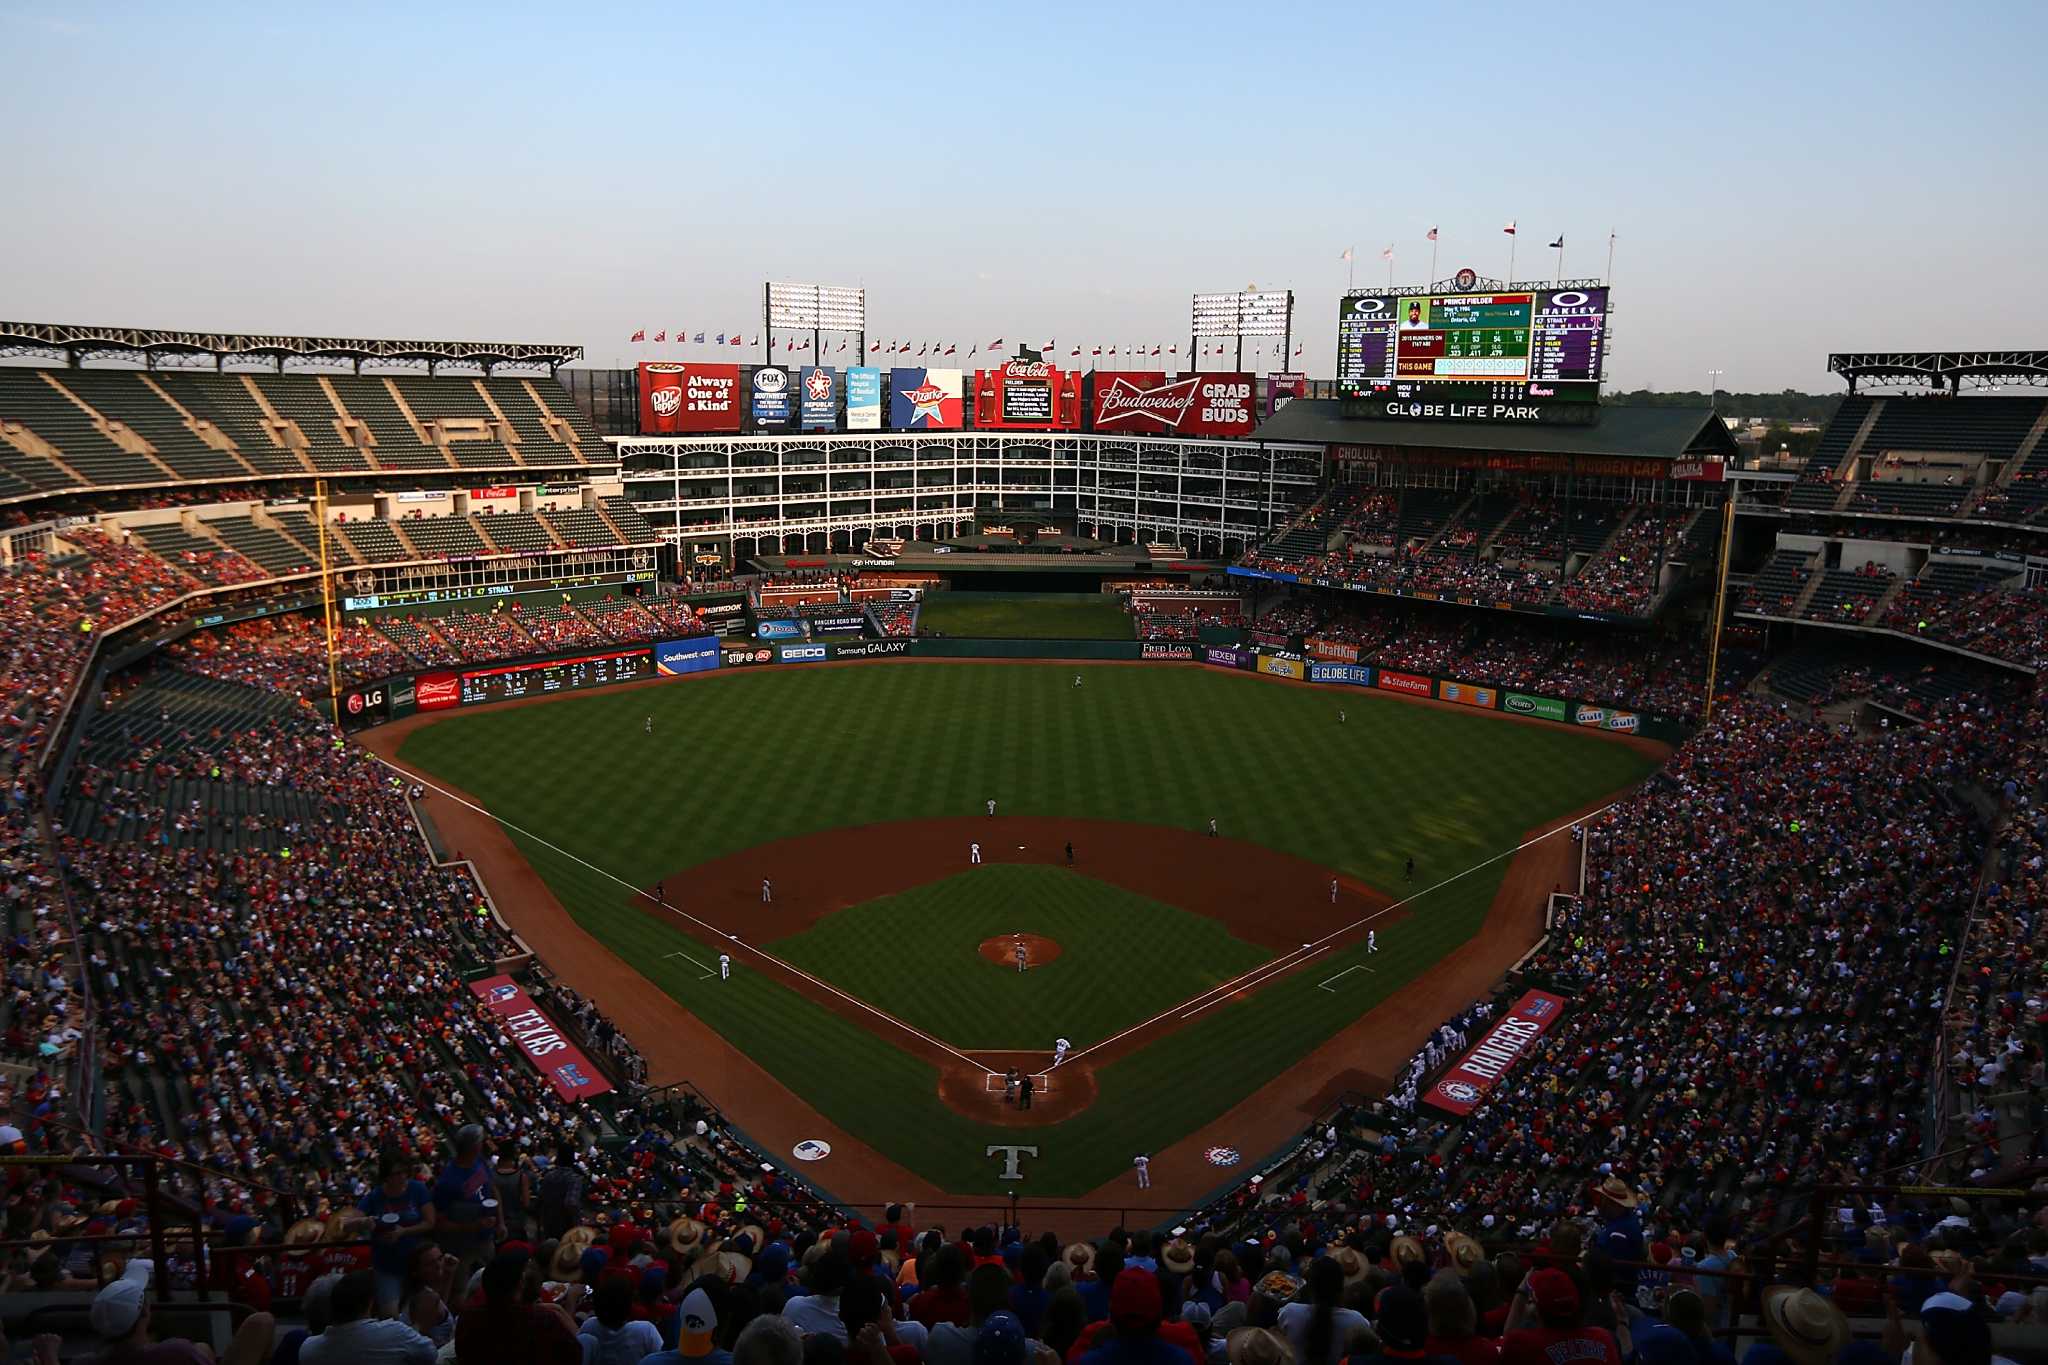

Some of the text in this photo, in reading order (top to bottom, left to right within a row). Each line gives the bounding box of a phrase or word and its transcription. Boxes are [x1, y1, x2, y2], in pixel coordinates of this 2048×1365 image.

[1346, 312, 1391, 320] OAKLEY
[1542, 307, 1596, 315] OAKLEY
[688, 376, 733, 388] Always
[762, 374, 780, 383] FOX
[661, 390, 675, 401] Dr
[688, 388, 729, 399] One of
[912, 390, 942, 403] Ozarka
[1202, 384, 1250, 398] GRAB
[652, 391, 681, 413] Pepper
[1099, 389, 1194, 409] Budweiser
[1210, 399, 1241, 408] SOME
[688, 400, 729, 410] a Kind
[1387, 402, 1540, 419] GLOBE LIFE PARK
[1202, 408, 1248, 422] BUDS
[1339, 447, 1382, 460] CHOLULA
[565, 554, 583, 563] JACK
[486, 561, 507, 570] JACK
[400, 568, 422, 577] JACK
[636, 572, 654, 581] MPH
[488, 585, 514, 594] STRAILY
[782, 648, 825, 658] GEICO
[837, 643, 906, 655] Samsung GALAXY
[1143, 644, 1191, 652] FRED LOYA
[729, 651, 770, 664] STOP @ DQ
[1209, 649, 1236, 660] NEXEN
[1322, 668, 1365, 680] GLOBE LIFE
[365, 690, 382, 708] LG
[1510, 699, 1533, 709] Scotts
[1579, 713, 1601, 721] Gulf
[1611, 719, 1635, 728] Gulf
[507, 1009, 567, 1056] TEXAS
[1460, 1016, 1540, 1078] RANGERS
[986, 1145, 1039, 1179] T
